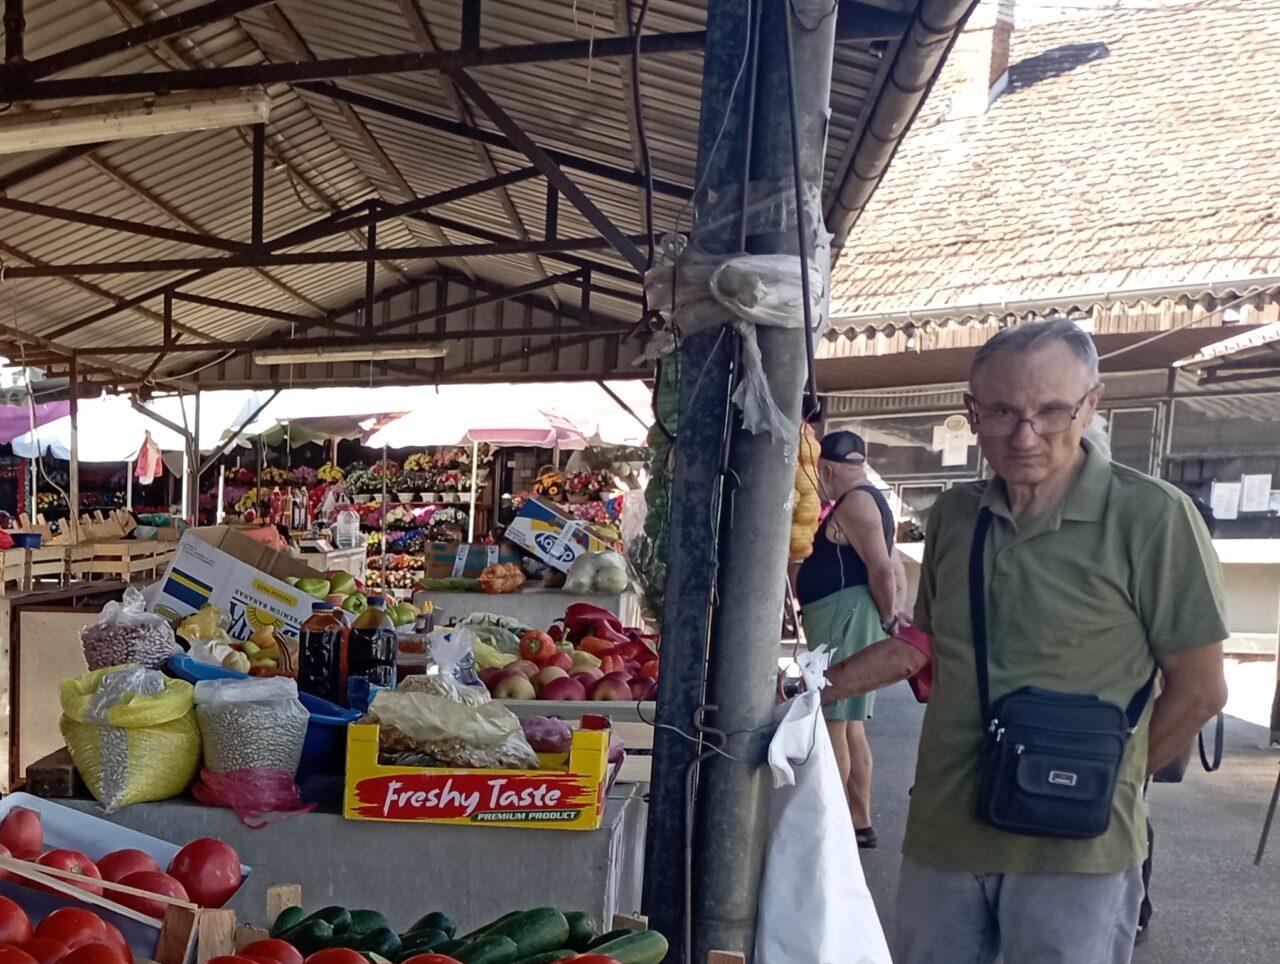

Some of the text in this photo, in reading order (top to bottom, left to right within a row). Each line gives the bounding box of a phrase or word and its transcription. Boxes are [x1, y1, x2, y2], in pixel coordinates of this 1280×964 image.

[234, 588, 268, 610] BANANAS
[269, 605, 304, 626] PREMIUM
[383, 778, 562, 817] Freshy Taste
[477, 810, 578, 822] PREMIUM PRODUCT
